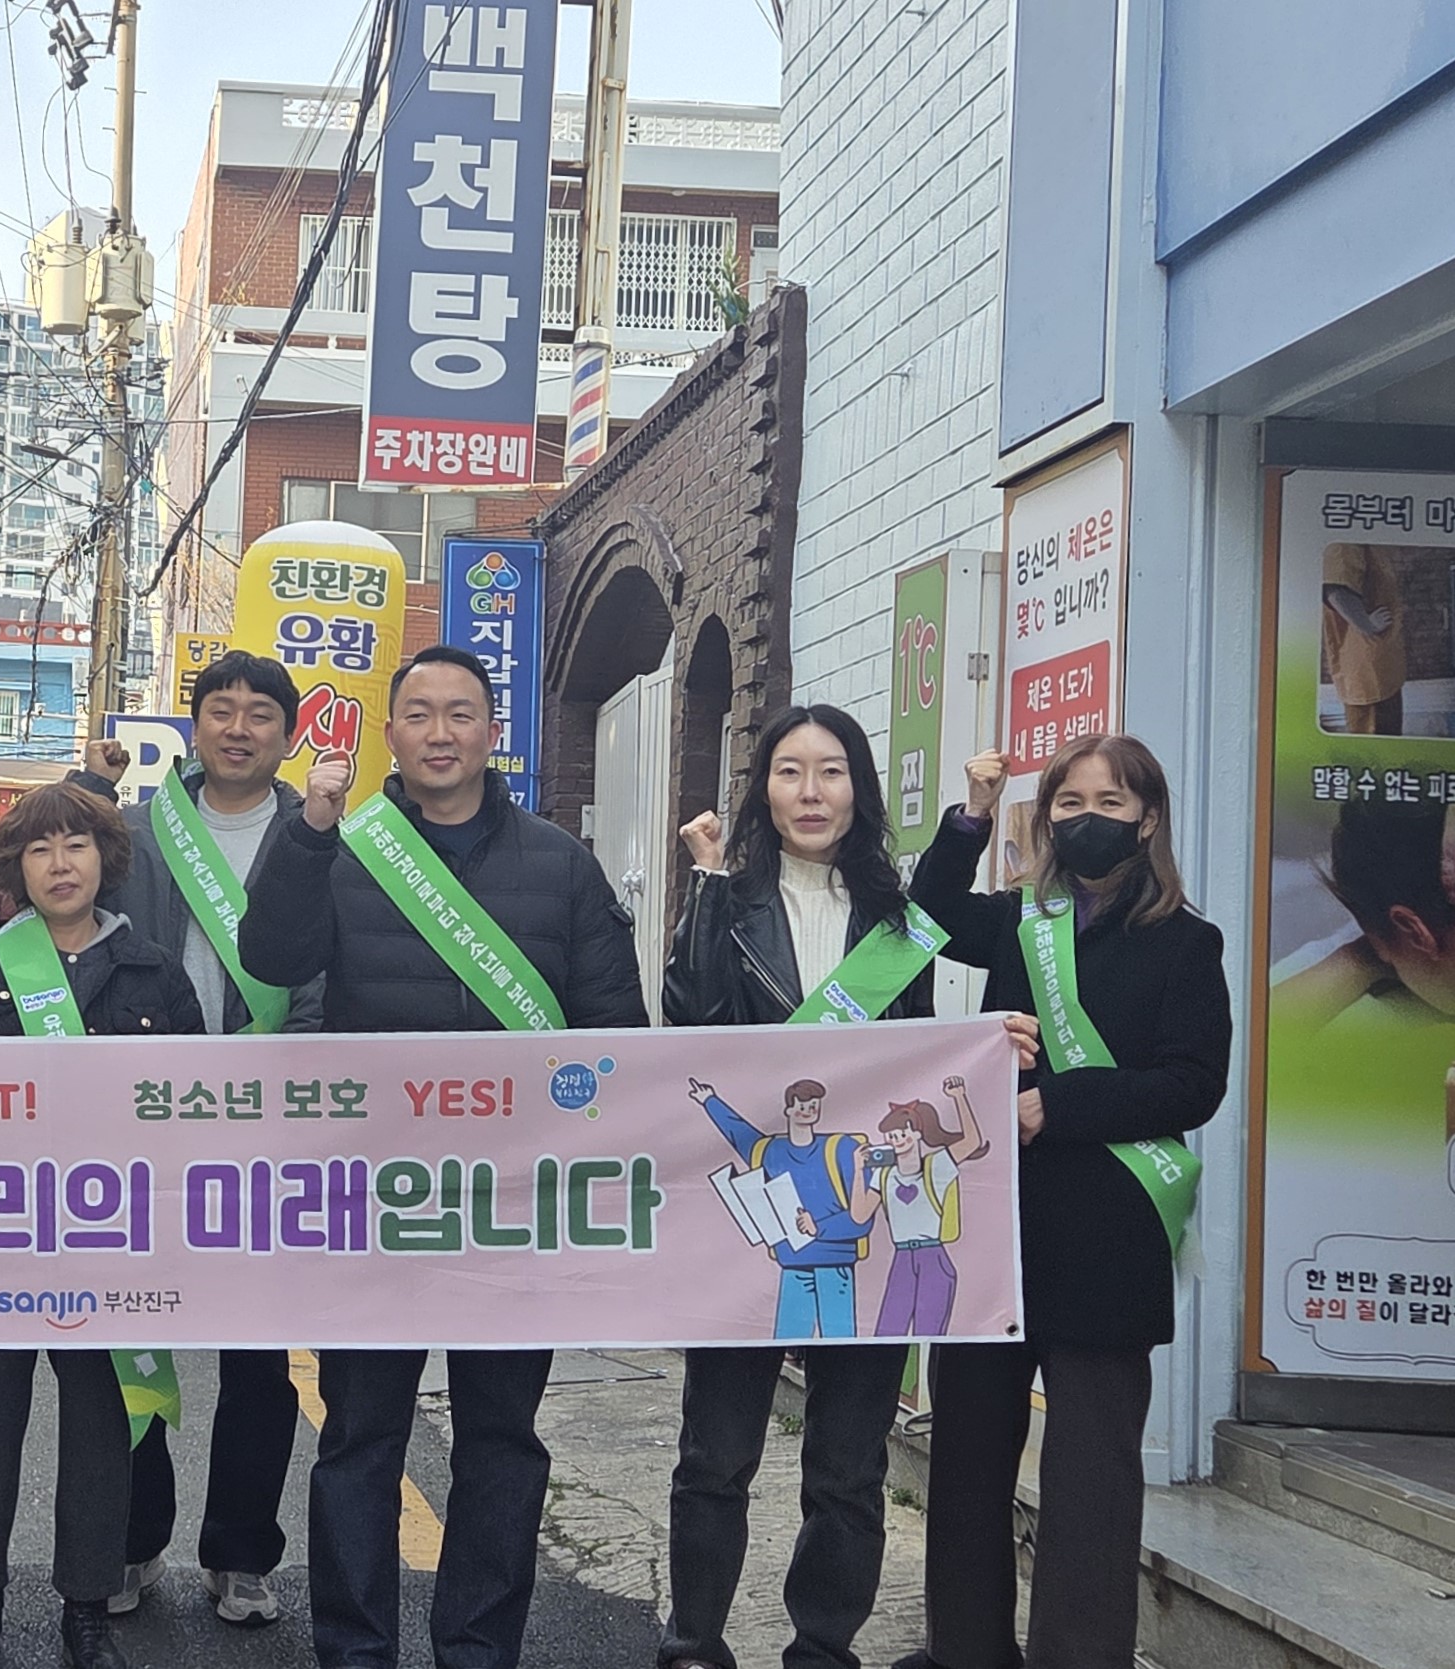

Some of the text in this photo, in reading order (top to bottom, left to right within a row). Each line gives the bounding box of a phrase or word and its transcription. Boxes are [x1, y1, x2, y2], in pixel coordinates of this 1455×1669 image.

[374, 428, 527, 478] 주차장완비
[1322, 493, 1414, 532] 몸부터
[1017, 508, 1114, 586] 당신의 체온은
[270, 559, 388, 608] 친환경
[469, 591, 516, 615] GH
[1054, 567, 1110, 627] 입니까?
[276, 613, 376, 672] 유황
[1027, 662, 1094, 713] 체온 1도가
[115, 720, 187, 808] P
[1015, 729, 1027, 762] 내
[1032, 721, 1058, 760] 몸을
[1313, 767, 1351, 800] 말할
[1357, 769, 1376, 801] 수
[1384, 770, 1421, 802] 없는
[365, 820, 460, 930] 유해환경으로부터
[452, 923, 514, 989] 청소년을
[133, 1079, 514, 1121] 청소년 보호 YES!
[185, 1156, 663, 1255] 미래입니다
[103, 1290, 183, 1314] 부산진구
[1306, 1269, 1453, 1298] 한 번만 올라와
[1304, 1297, 1455, 1326] 삶의 질이 달라
